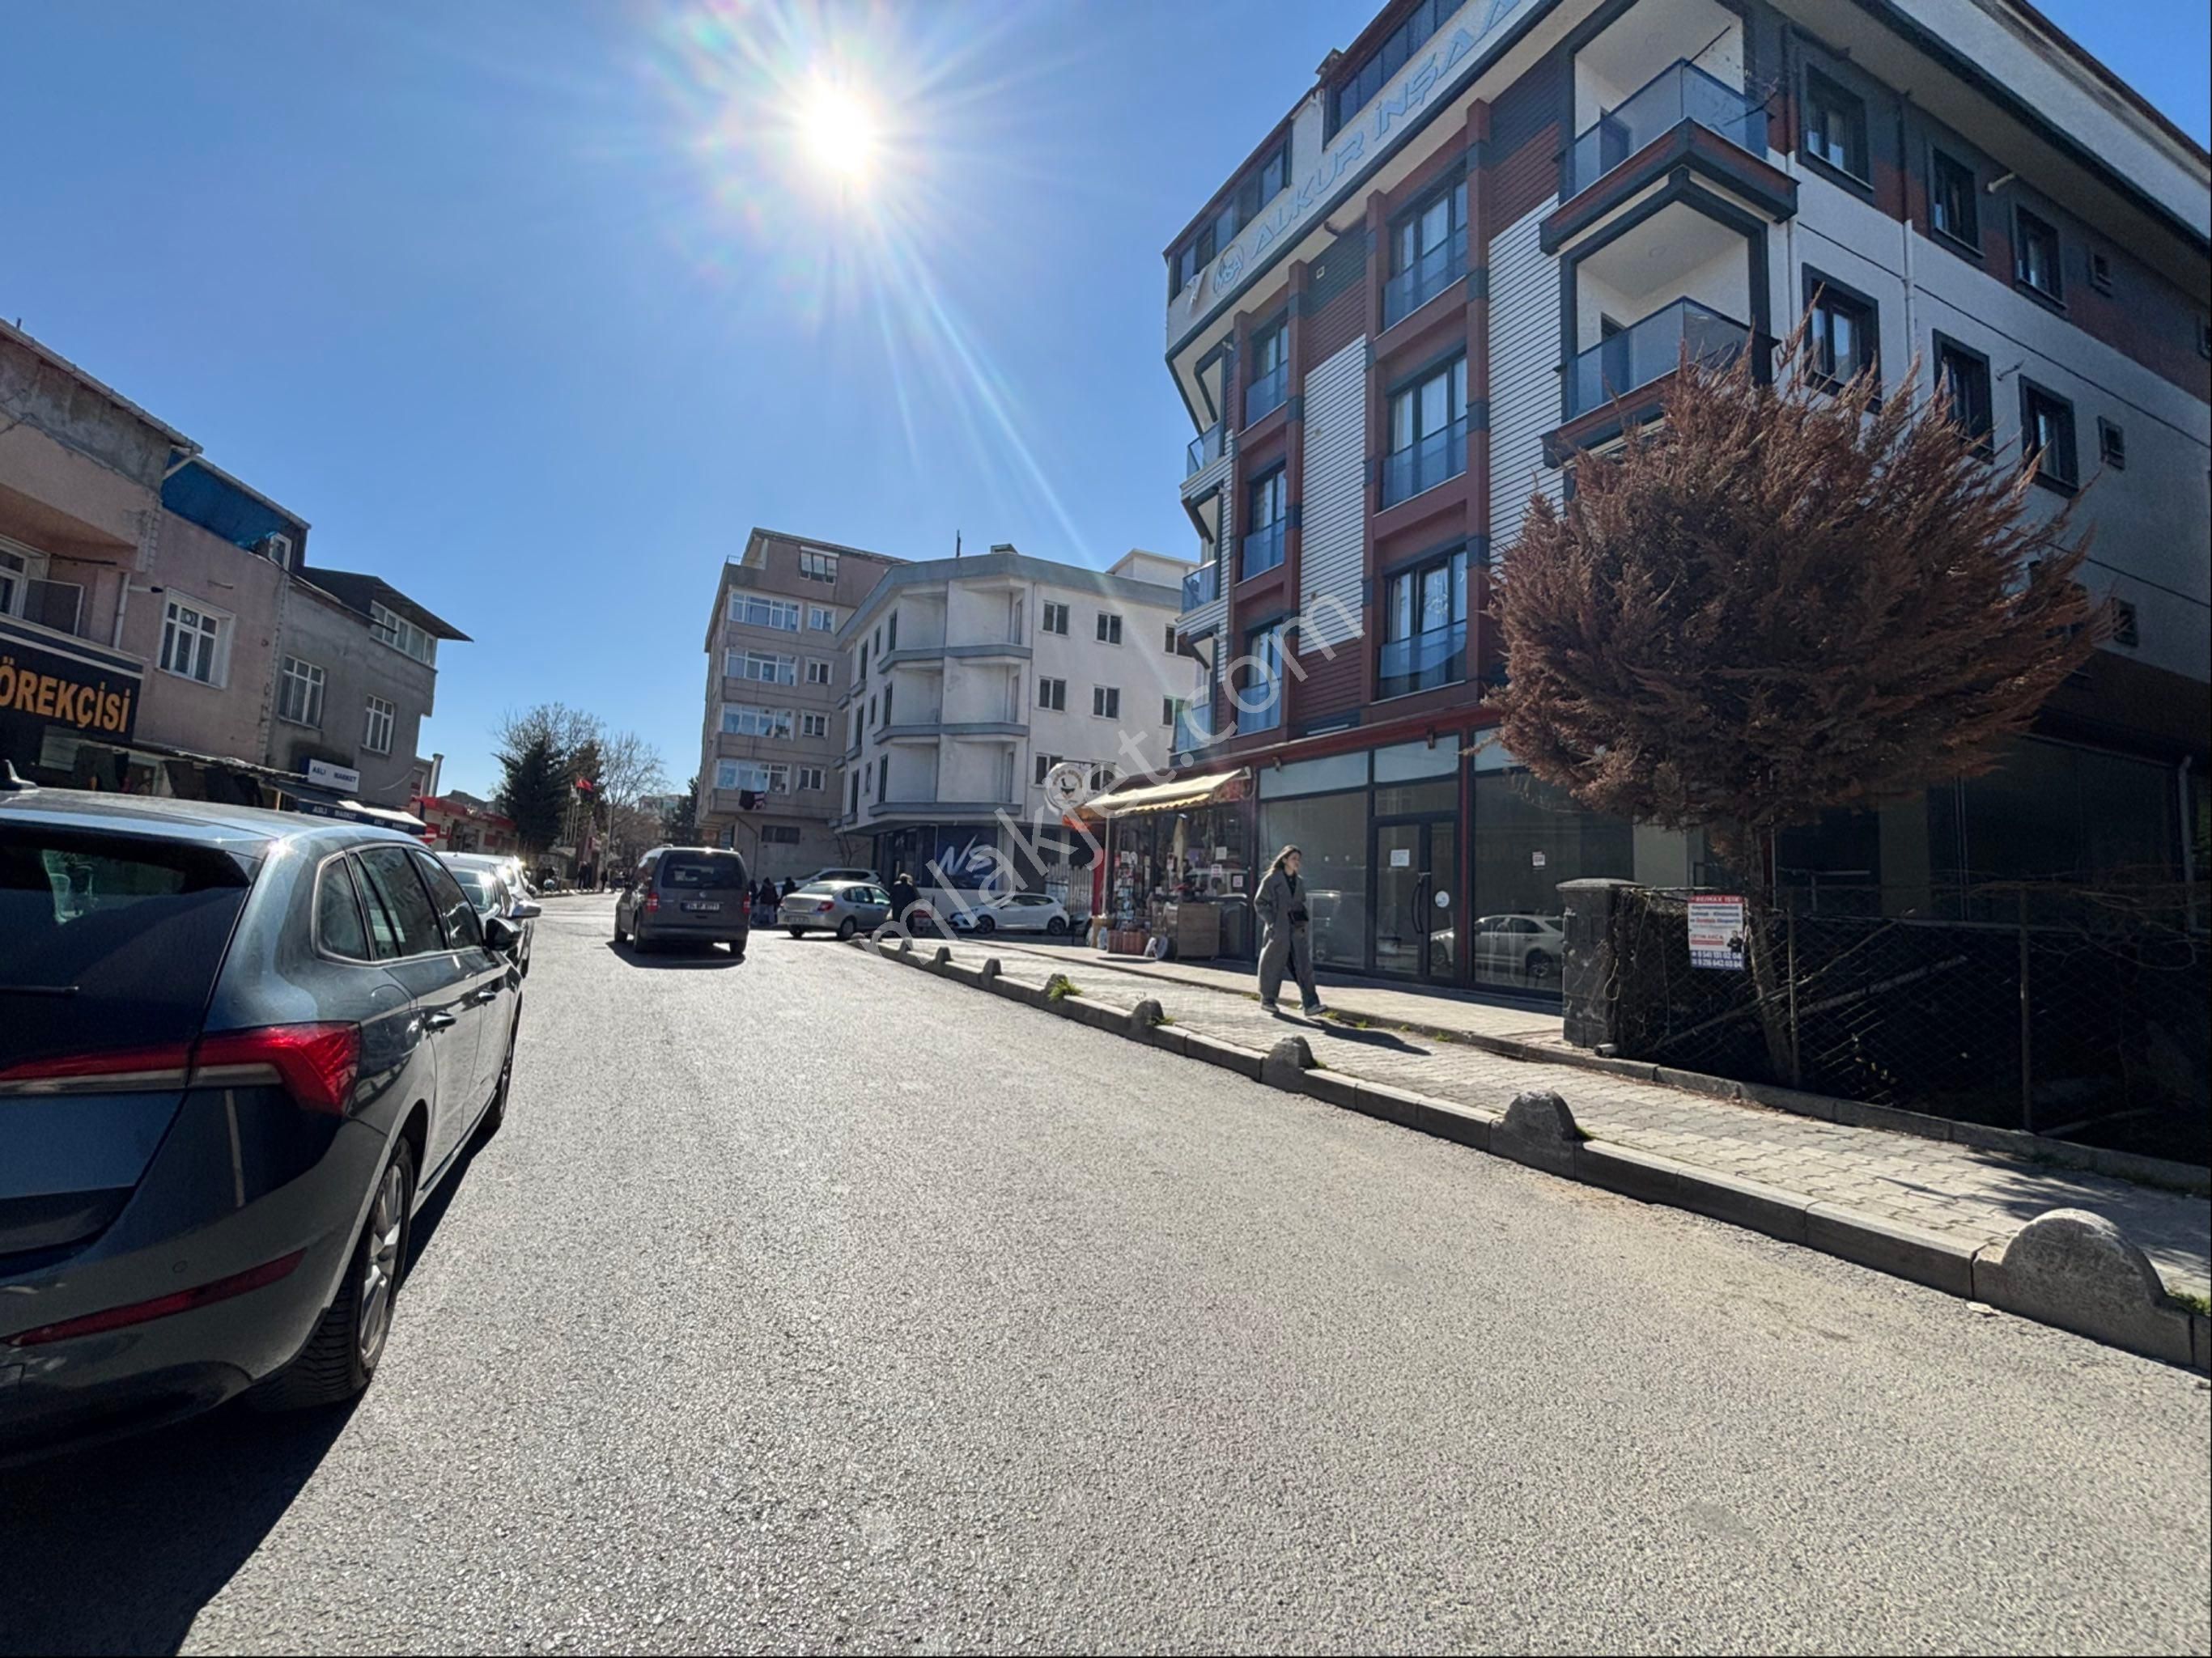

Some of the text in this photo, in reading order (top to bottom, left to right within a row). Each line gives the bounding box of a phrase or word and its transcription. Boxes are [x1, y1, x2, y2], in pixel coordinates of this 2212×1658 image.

[1251, 130, 1365, 261] ALKUR
[333, 772, 357, 782] MARKET
[334, 810, 357, 820] MARKET
